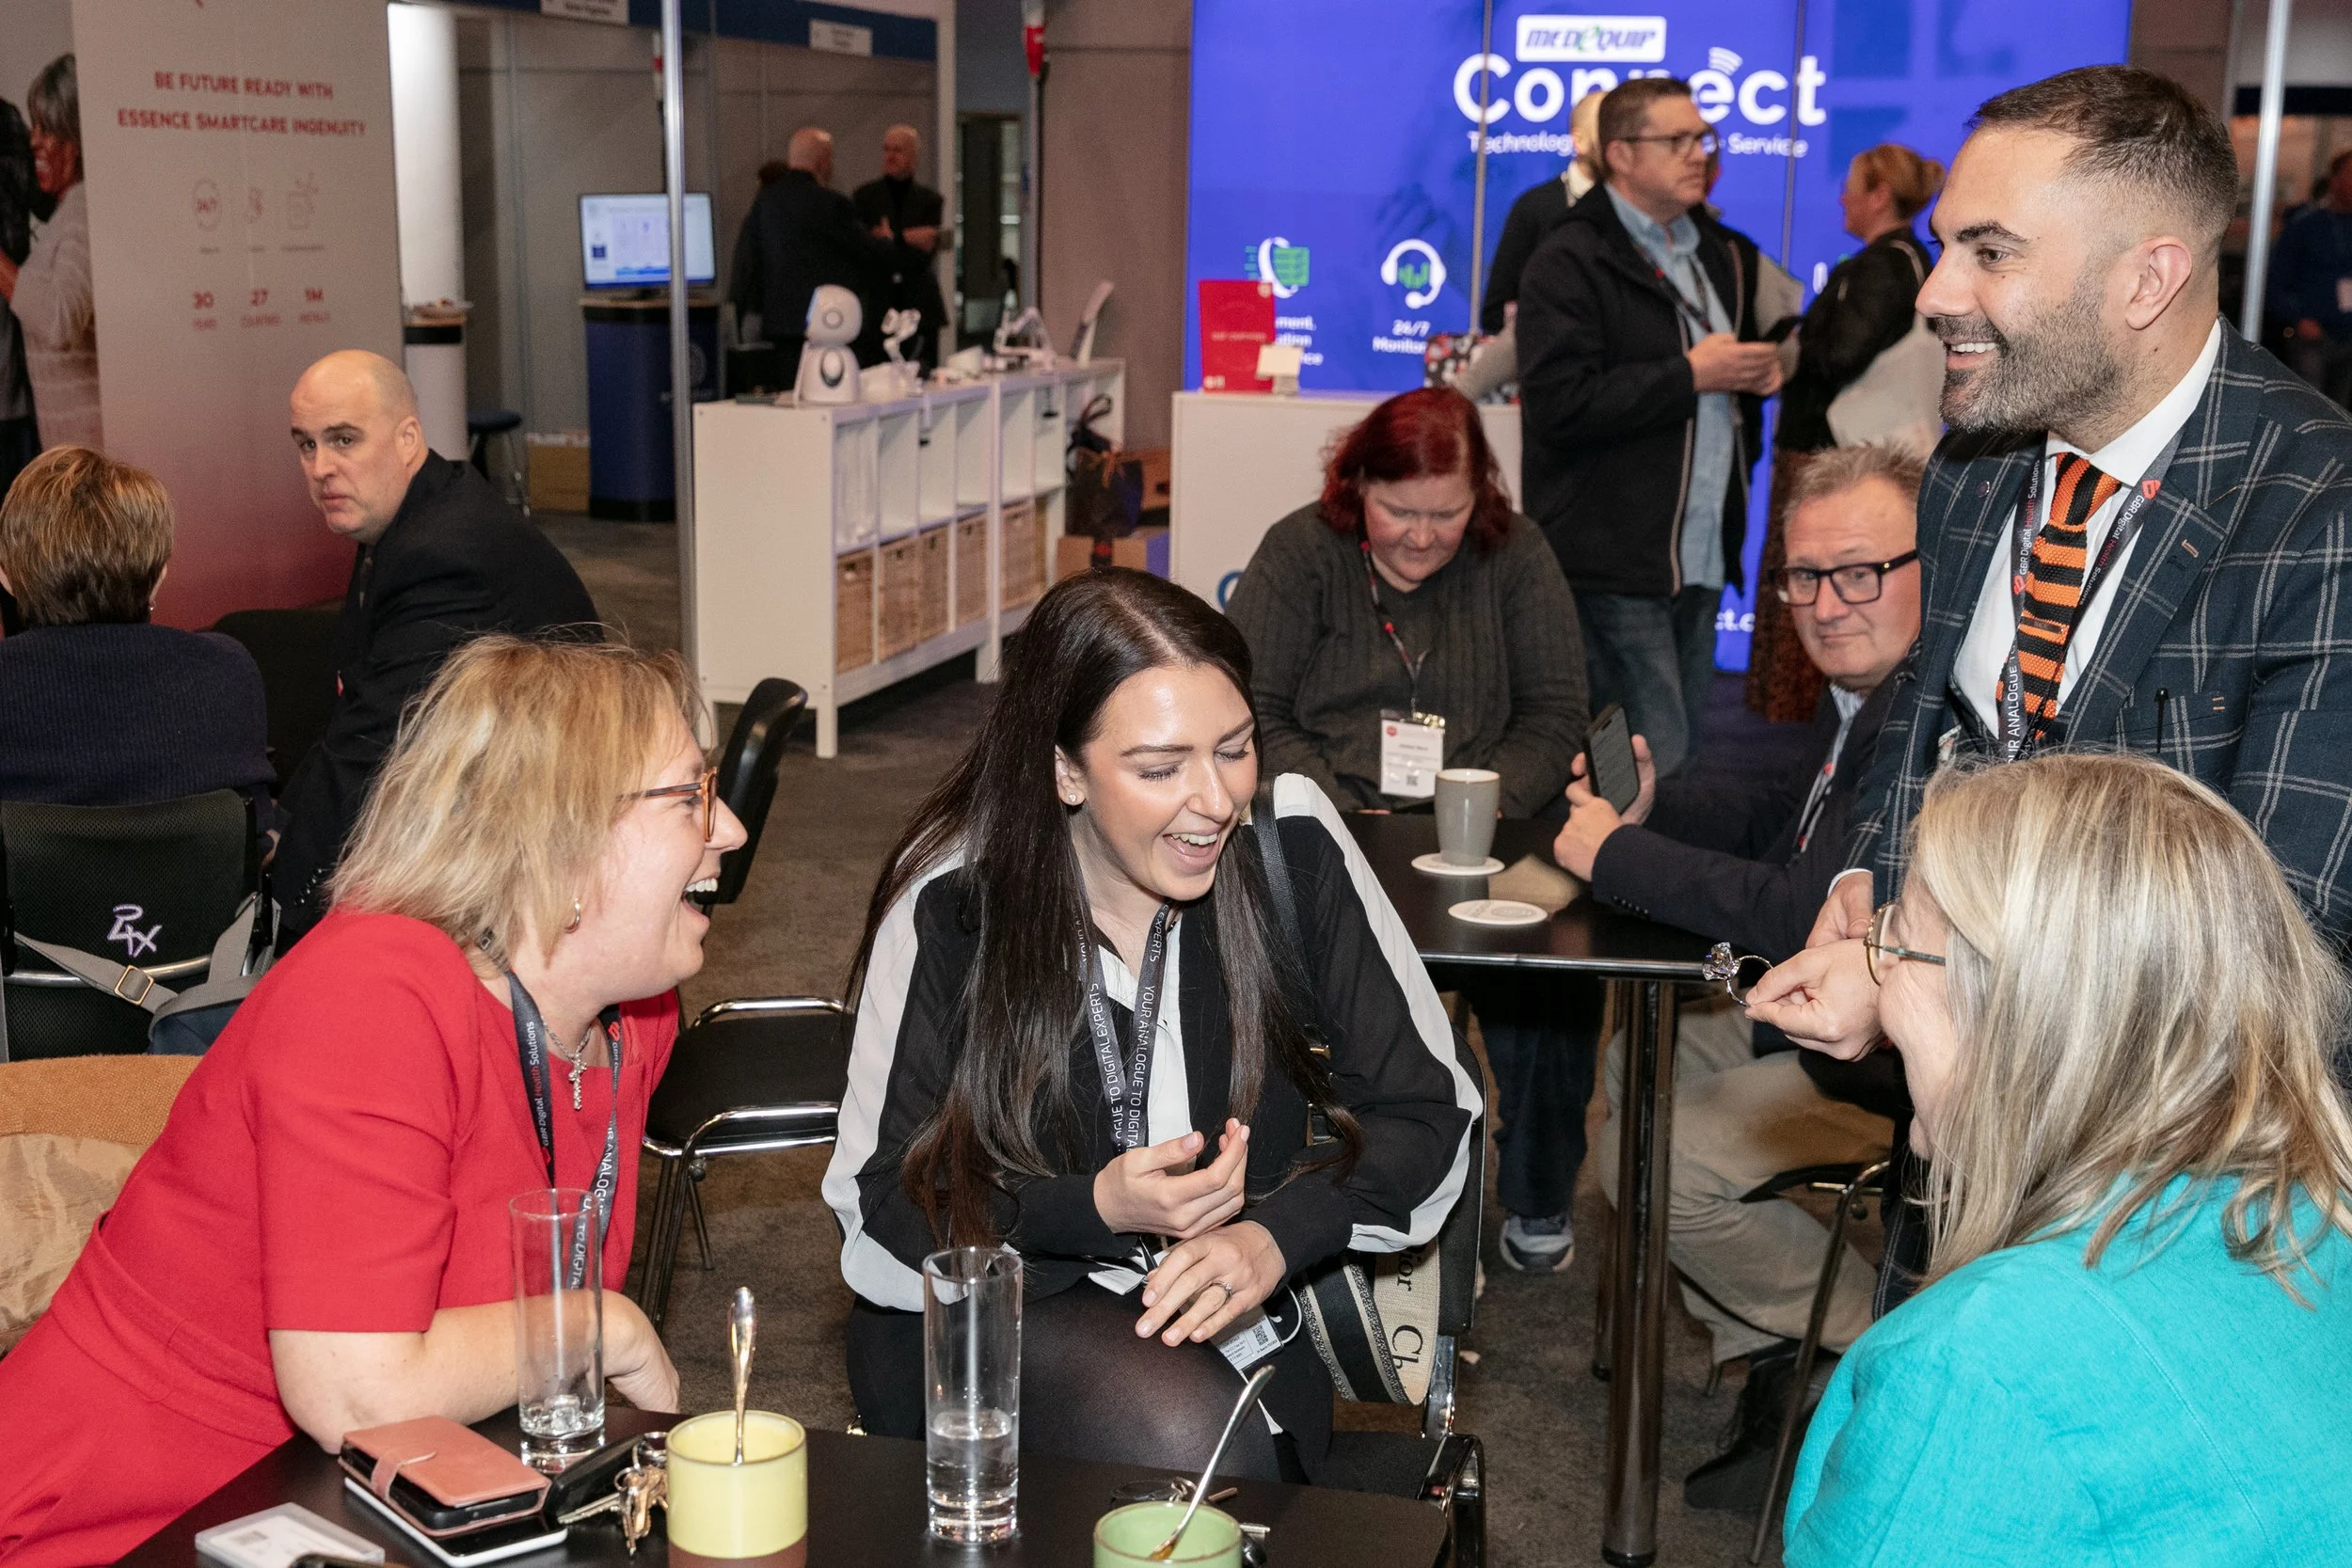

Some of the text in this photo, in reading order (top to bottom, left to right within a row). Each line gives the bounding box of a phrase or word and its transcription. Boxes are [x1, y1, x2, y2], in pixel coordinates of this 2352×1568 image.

[154, 71, 333, 99] BE FUTURE READY WITH
[1454, 53, 1827, 126] Conect
[118, 108, 190, 130] ESSENCE
[196, 112, 287, 134] SMARTCARE
[1468, 131, 1574, 156] Technolog
[1727, 132, 1809, 158] Service
[2130, 495, 2144, 517] GBR
[2007, 665, 2020, 736] ANALOGUE
[1089, 983, 1108, 1037] EXPERTS
[526, 1021, 540, 1066] Solutions
[1126, 911, 1166, 1153] EXPERTS YOUR ANALOGUE TO DIGITA
[1101, 1037, 1119, 1085] DIGITAL
[1109, 1087, 1121, 1105] TO
